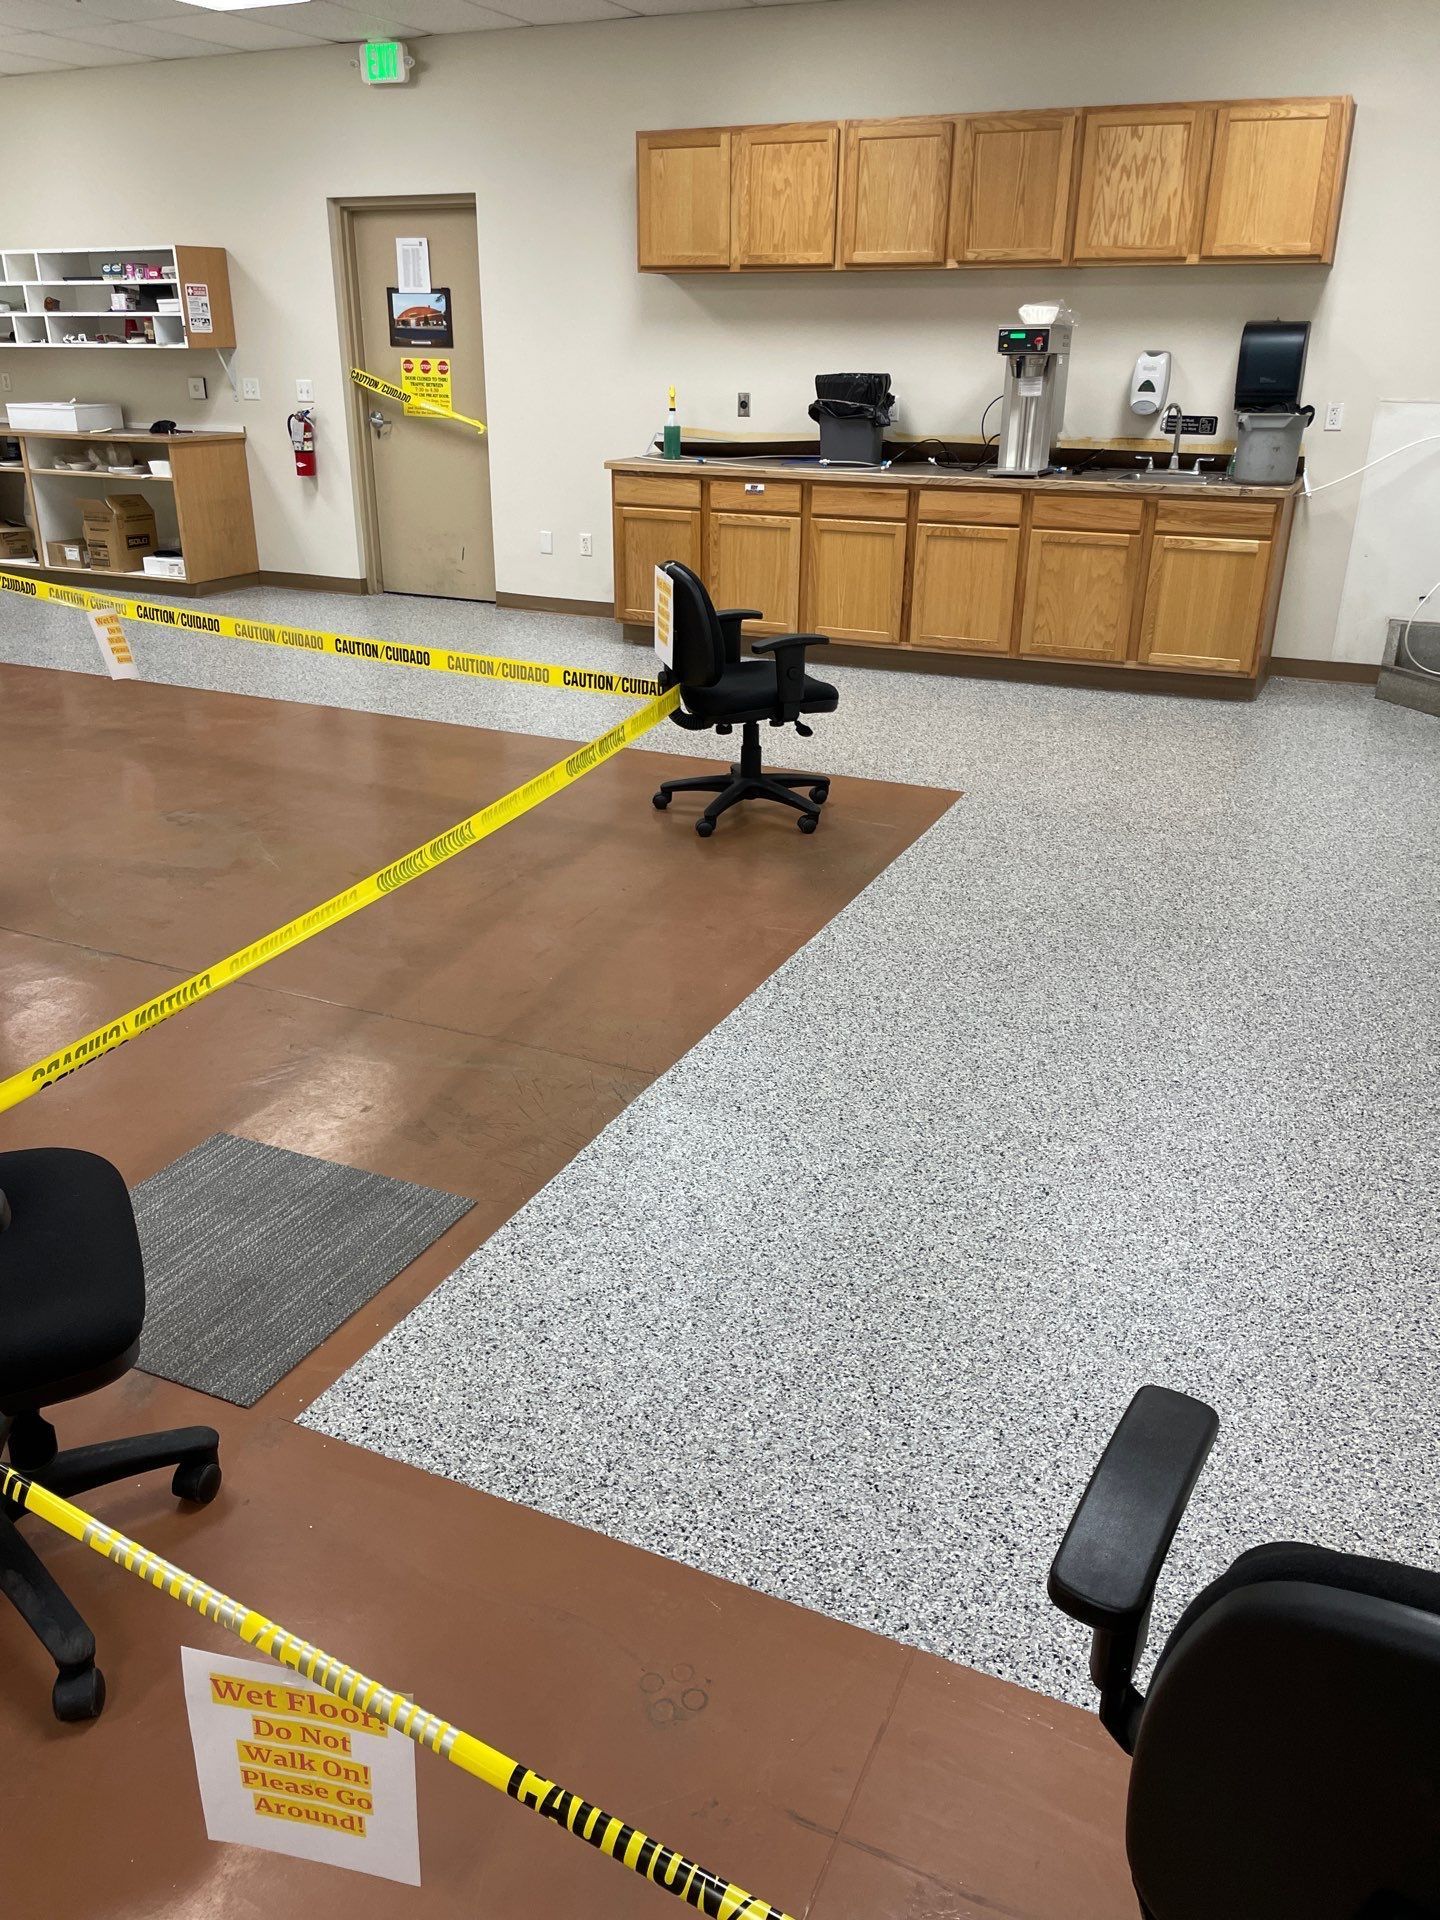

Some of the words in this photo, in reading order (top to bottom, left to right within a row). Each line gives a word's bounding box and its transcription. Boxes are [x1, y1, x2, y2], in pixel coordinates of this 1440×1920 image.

[366, 43, 398, 80] EXIT
[210, 1677, 278, 1708] Wet
[252, 1718, 292, 1740] Do
[300, 1726, 352, 1753] Not
[242, 1744, 317, 1772] Walk
[322, 1760, 370, 1785] On!
[241, 1769, 329, 1800] Please
[336, 1789, 373, 1811] Go
[254, 1797, 365, 1834] Around!
